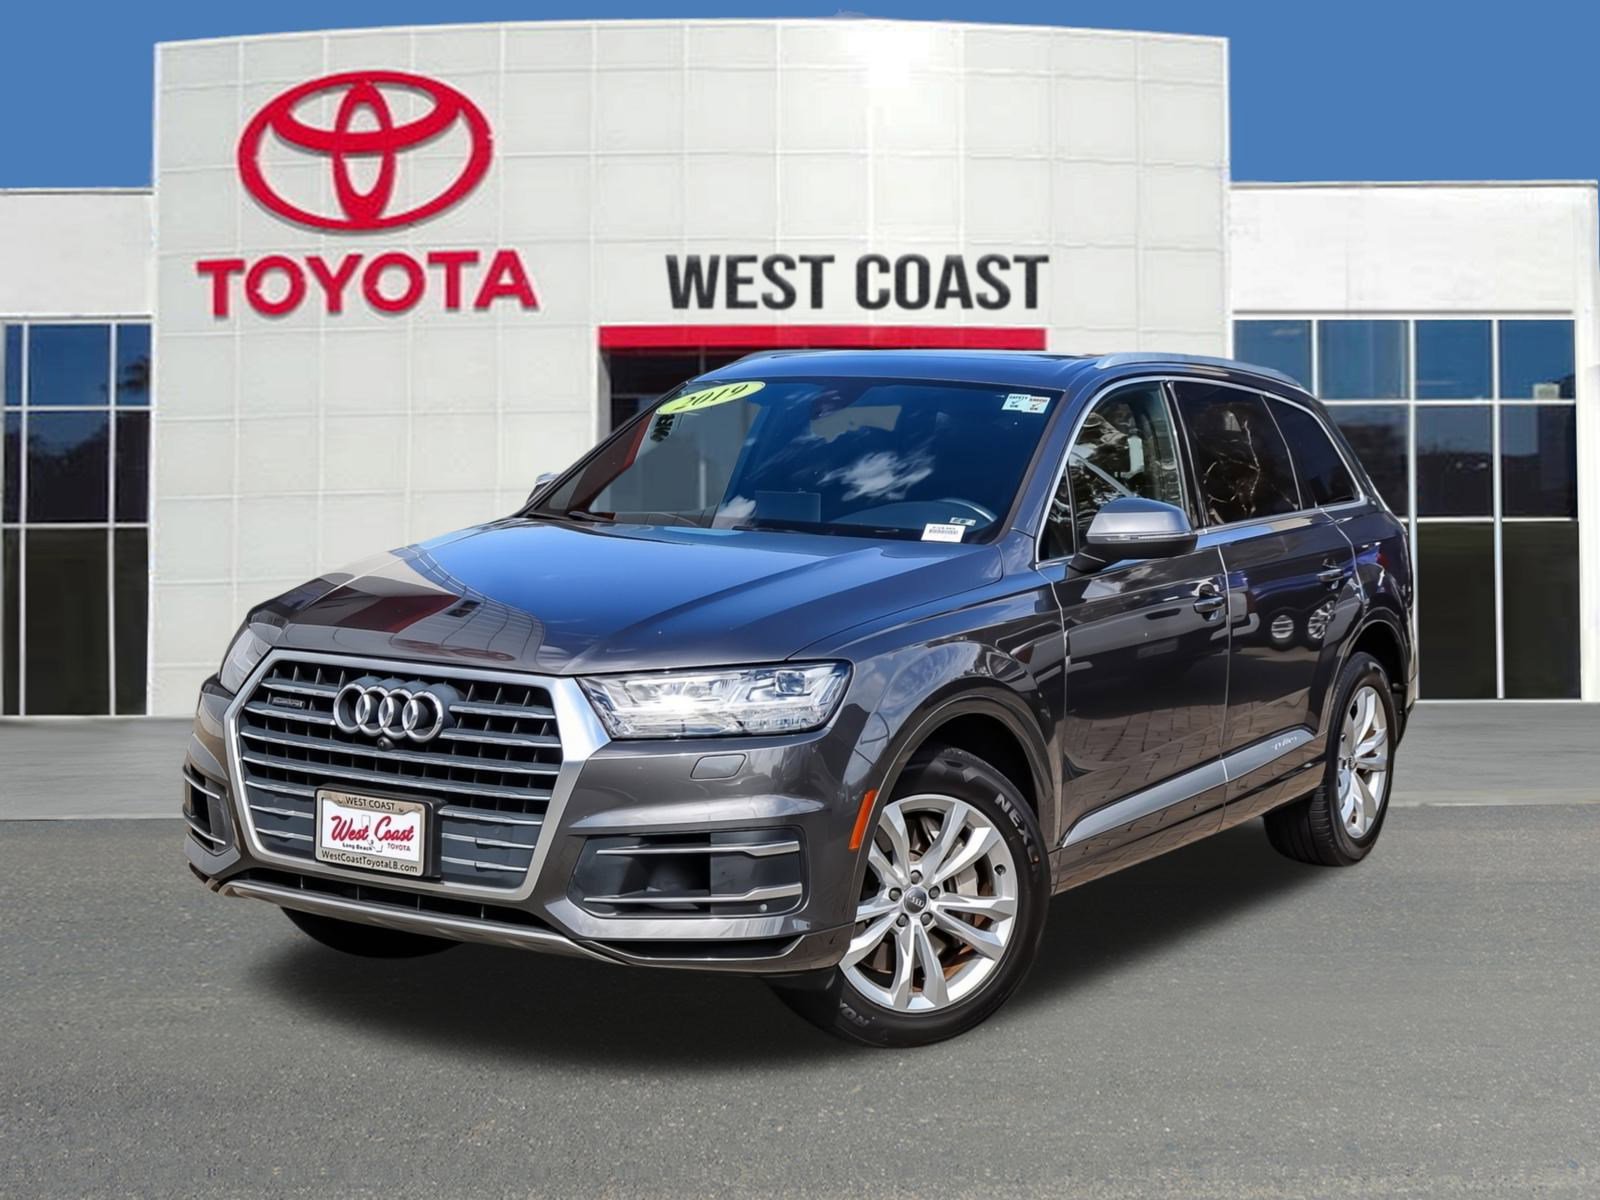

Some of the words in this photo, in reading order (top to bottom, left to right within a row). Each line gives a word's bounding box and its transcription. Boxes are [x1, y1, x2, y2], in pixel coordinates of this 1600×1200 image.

[196, 250, 539, 318] TOYOTA
[665, 253, 836, 311] WEST
[855, 253, 1050, 311] COAST
[671, 383, 750, 412] 2019
[345, 796, 367, 808] WEST
[368, 799, 395, 811] COAST
[331, 815, 370, 842] West
[374, 815, 415, 842] Coast
[342, 842, 355, 851] Long
[356, 844, 373, 852] Beach
[387, 842, 412, 852] TOYOTA
[321, 850, 418, 873] WestCoastToyotaLB.com
